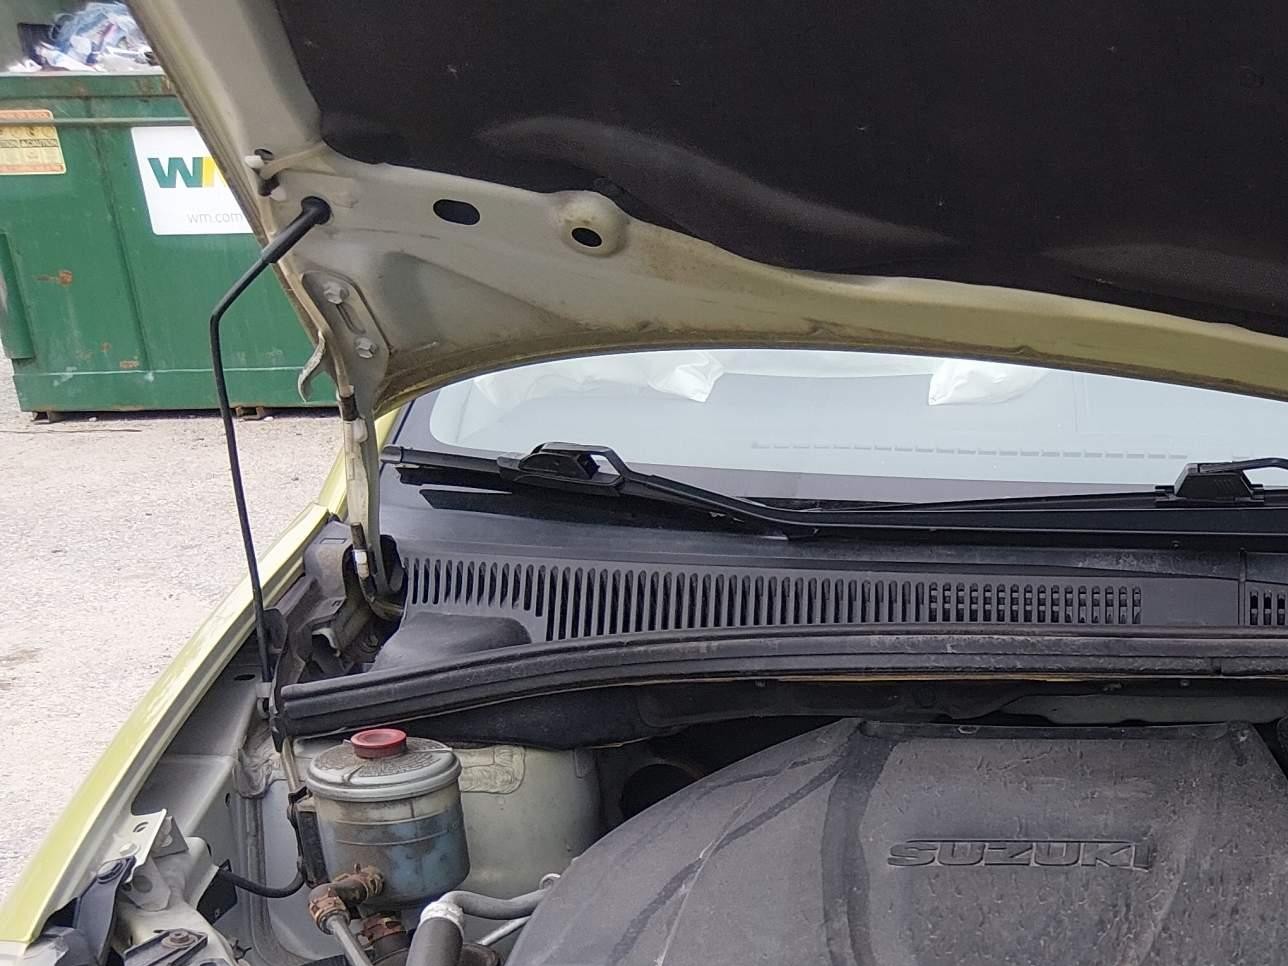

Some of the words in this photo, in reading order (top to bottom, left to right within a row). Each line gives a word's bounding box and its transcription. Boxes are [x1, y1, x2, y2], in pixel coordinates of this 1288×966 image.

[148, 157, 226, 188] W
[187, 213, 243, 224] wm.com
[887, 840, 1153, 871] SUZUKI
